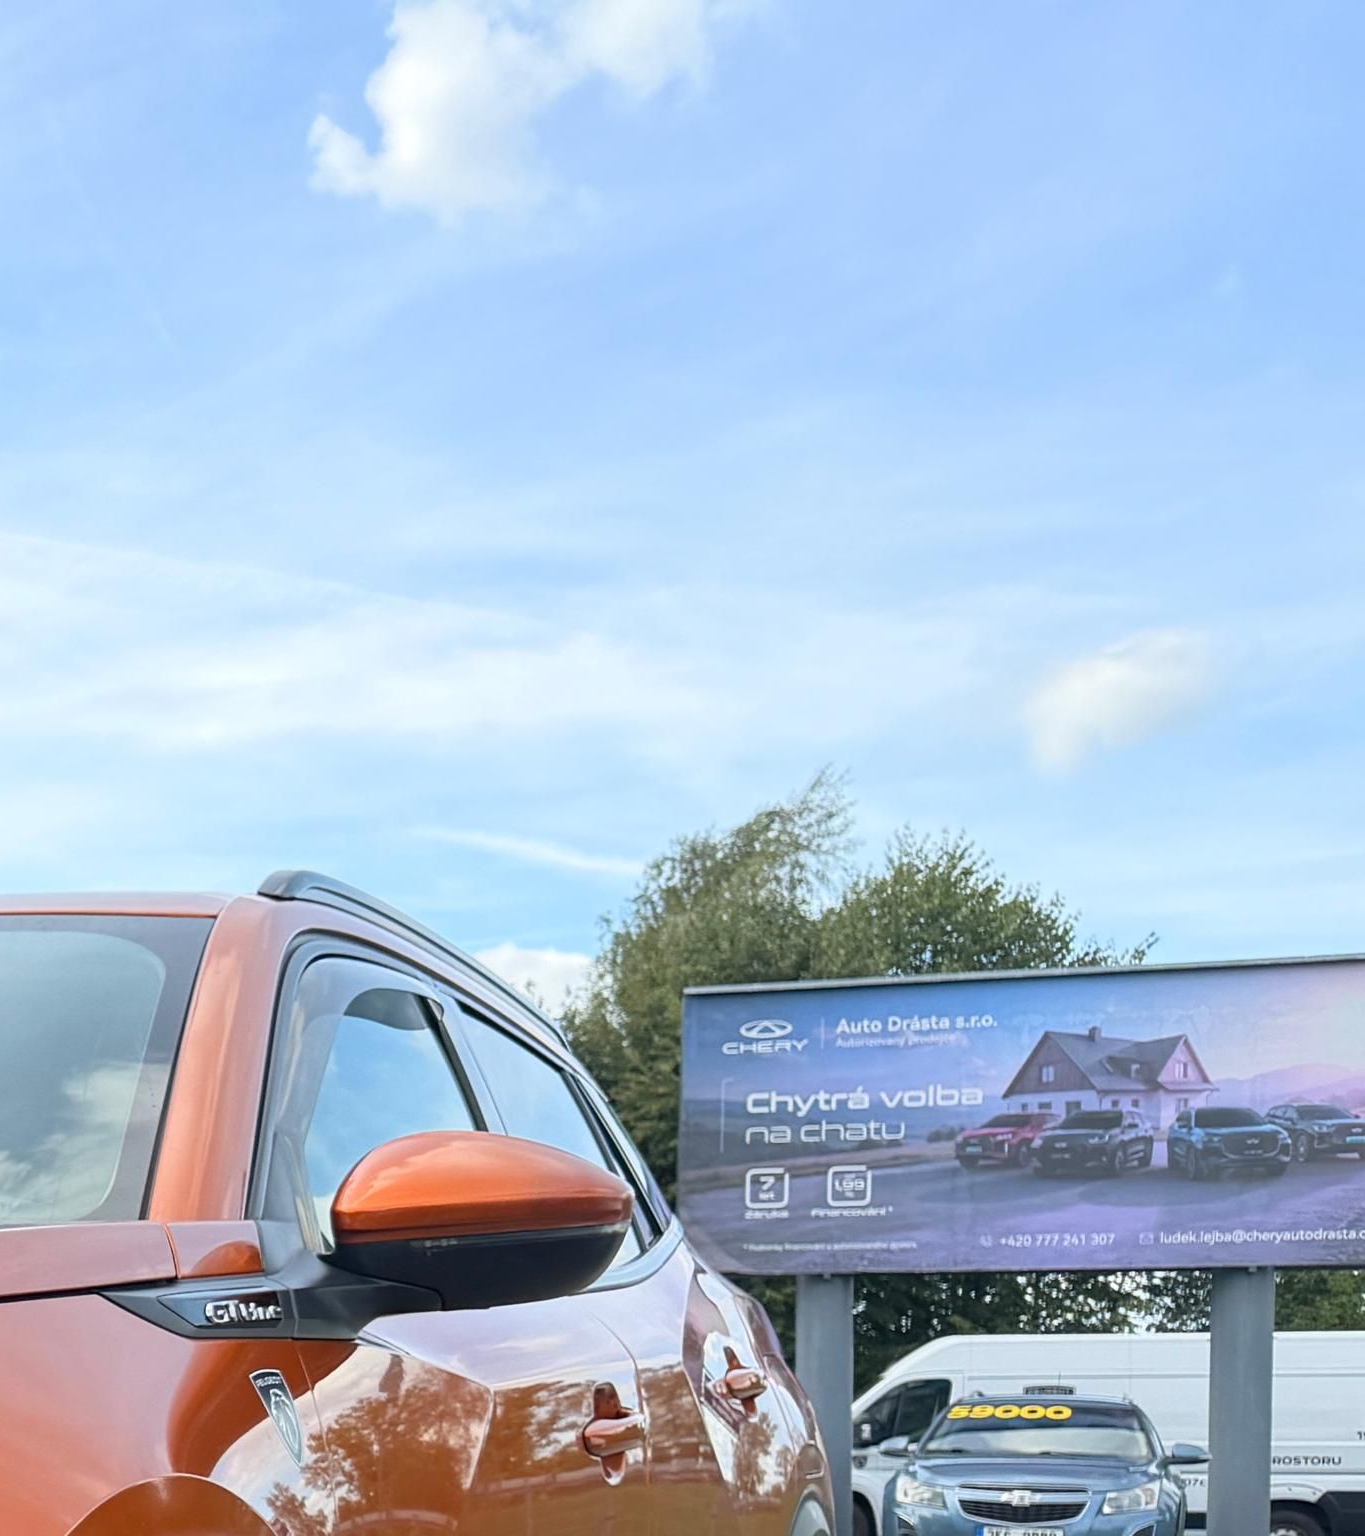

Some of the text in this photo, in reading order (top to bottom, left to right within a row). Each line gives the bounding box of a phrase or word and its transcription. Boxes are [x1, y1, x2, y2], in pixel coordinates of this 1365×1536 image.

[836, 1014, 997, 1034] Auto Drásta s.r.o.
[722, 1039, 809, 1055] CHERY
[746, 1084, 983, 1117] Chytrá volba
[745, 1120, 905, 1144] na chatu
[760, 1176, 775, 1190] 7
[999, 1233, 1032, 1247] +420
[1036, 1233, 1059, 1247] 777
[1091, 1232, 1115, 1246] 307
[1272, 1455, 1342, 1466] ROSTORU
